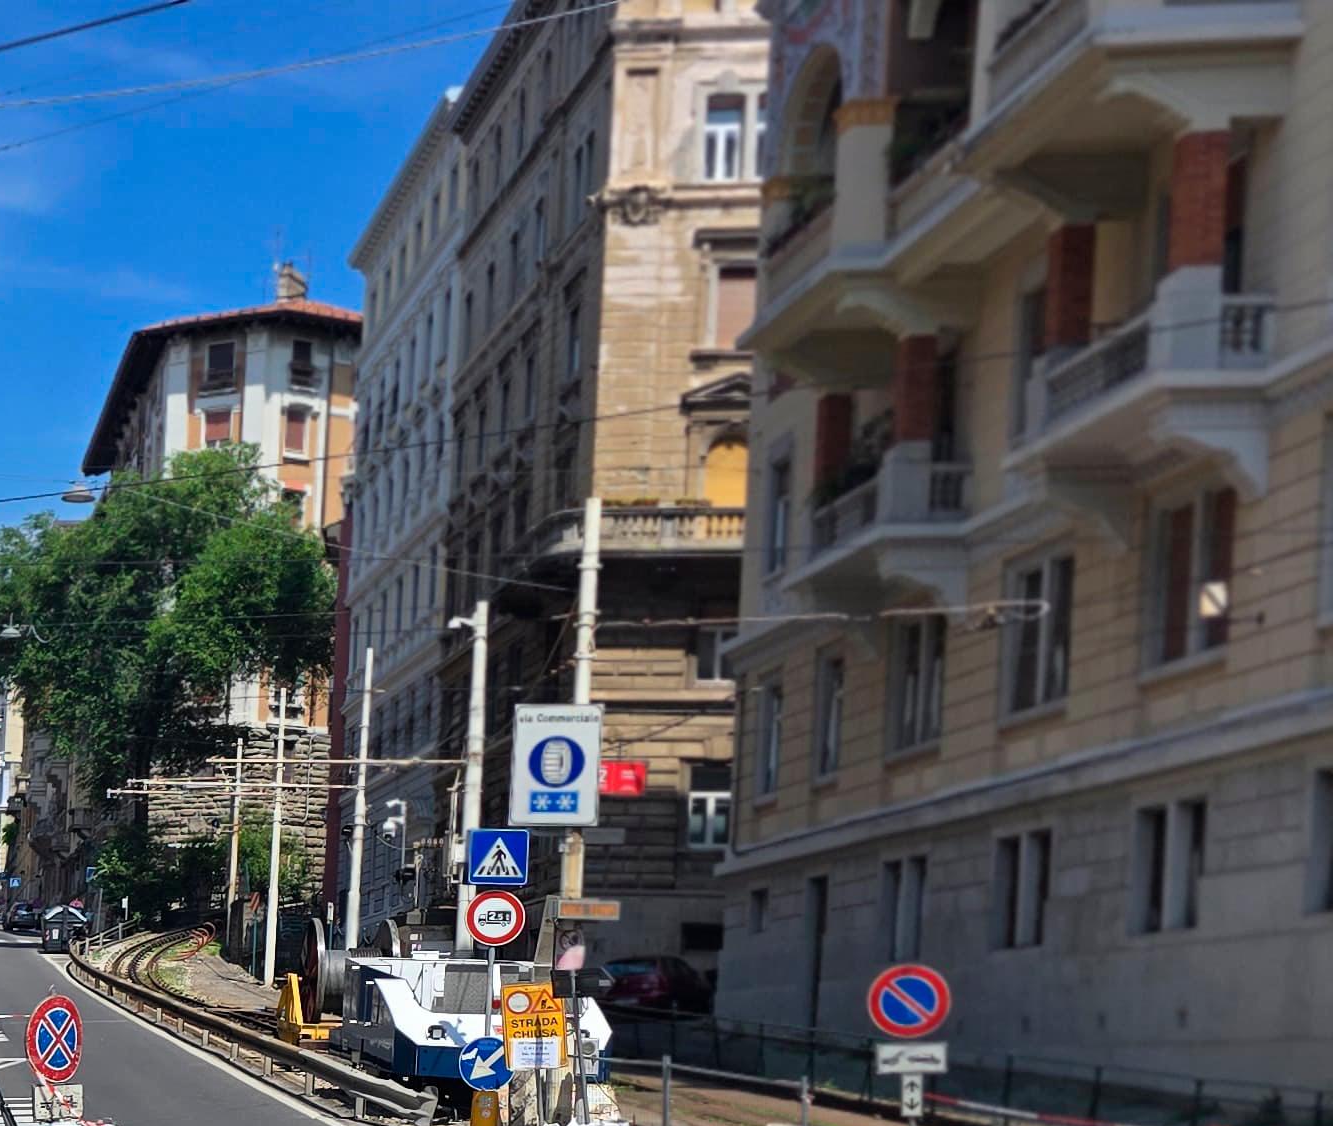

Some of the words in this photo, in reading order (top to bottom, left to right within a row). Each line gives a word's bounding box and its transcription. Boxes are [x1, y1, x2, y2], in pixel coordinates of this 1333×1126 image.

[536, 712, 600, 724] Commerciale
[511, 1016, 559, 1029] STRADA
[513, 1028, 559, 1039] CHIUSA
